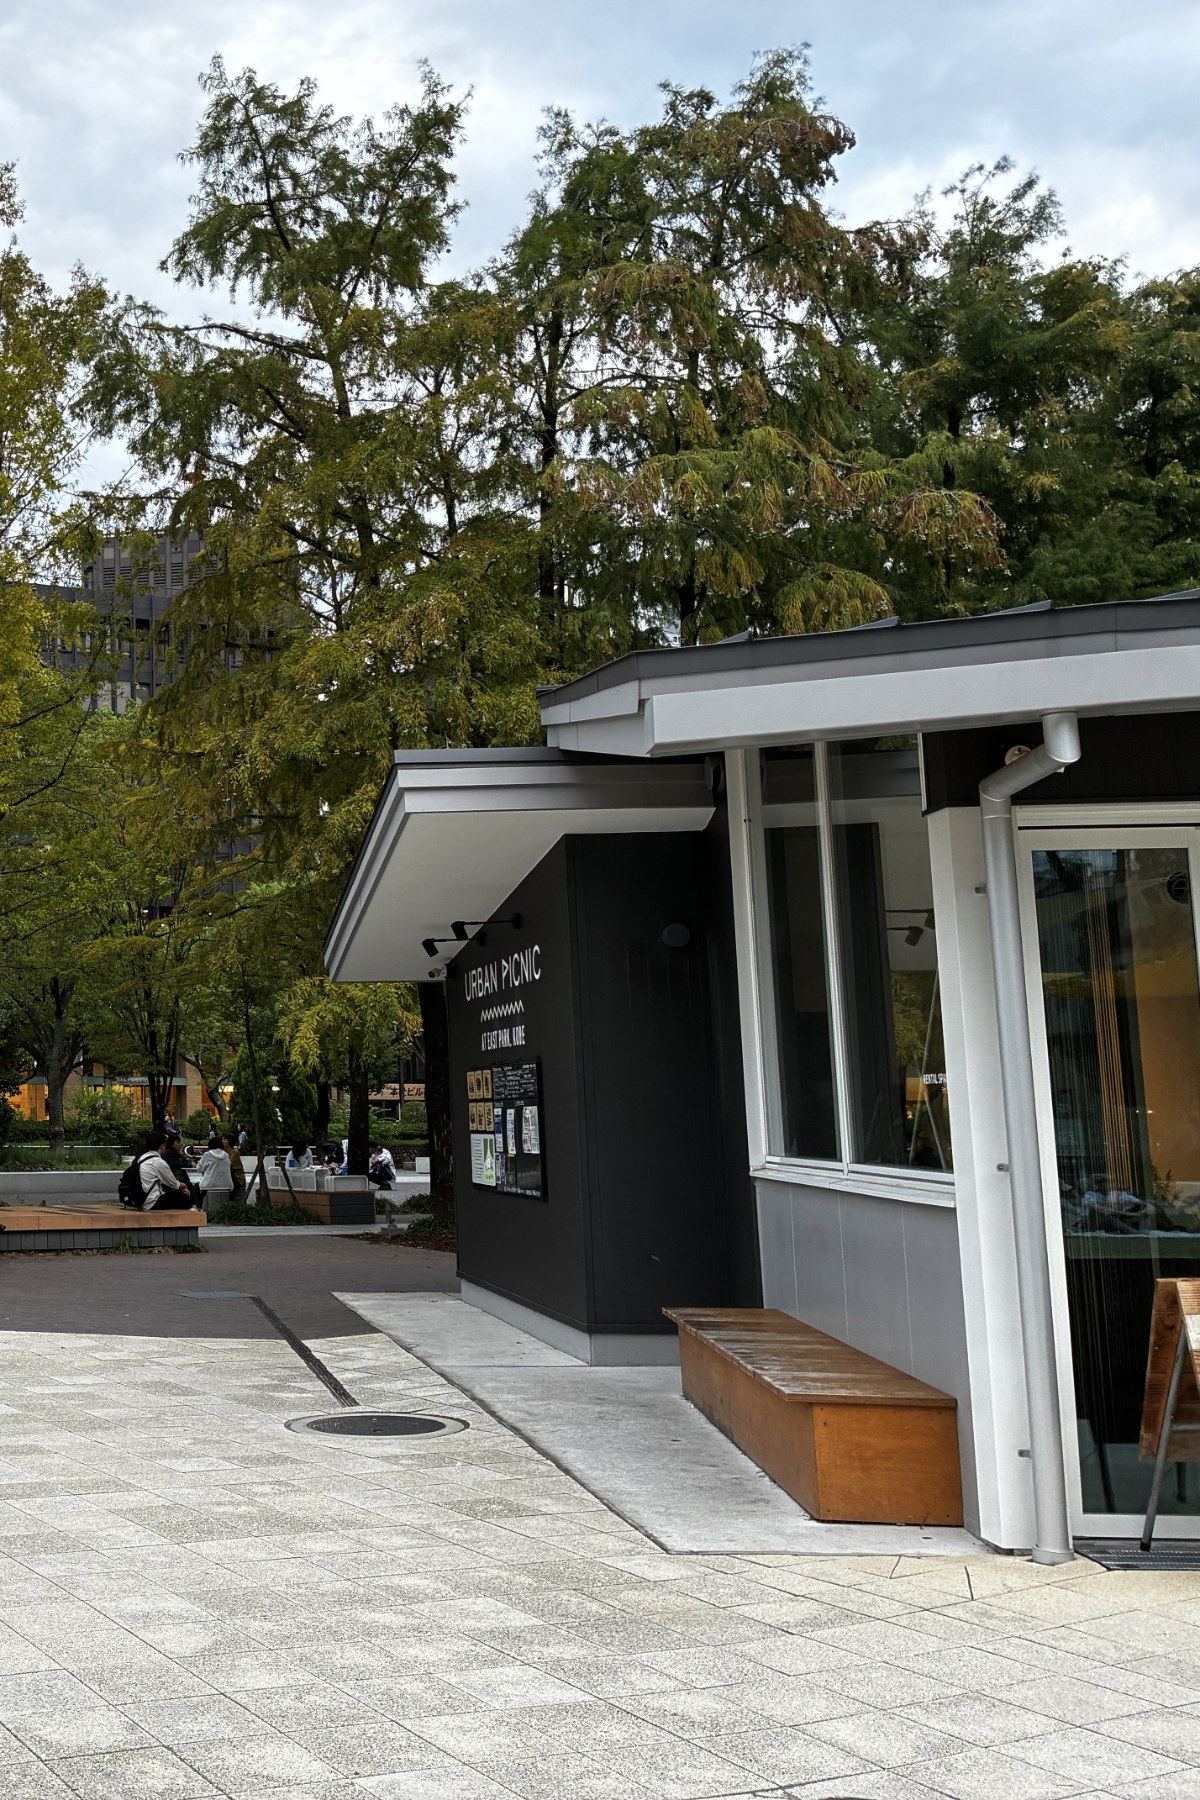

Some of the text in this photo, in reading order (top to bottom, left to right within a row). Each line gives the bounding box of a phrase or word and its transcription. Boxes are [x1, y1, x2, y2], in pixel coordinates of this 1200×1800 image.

[464, 944, 541, 1002] URBAN PICNIC
[481, 1032, 487, 1052] AT
[487, 1030, 498, 1050] EAST
[512, 1024, 526, 1046] KOBE
